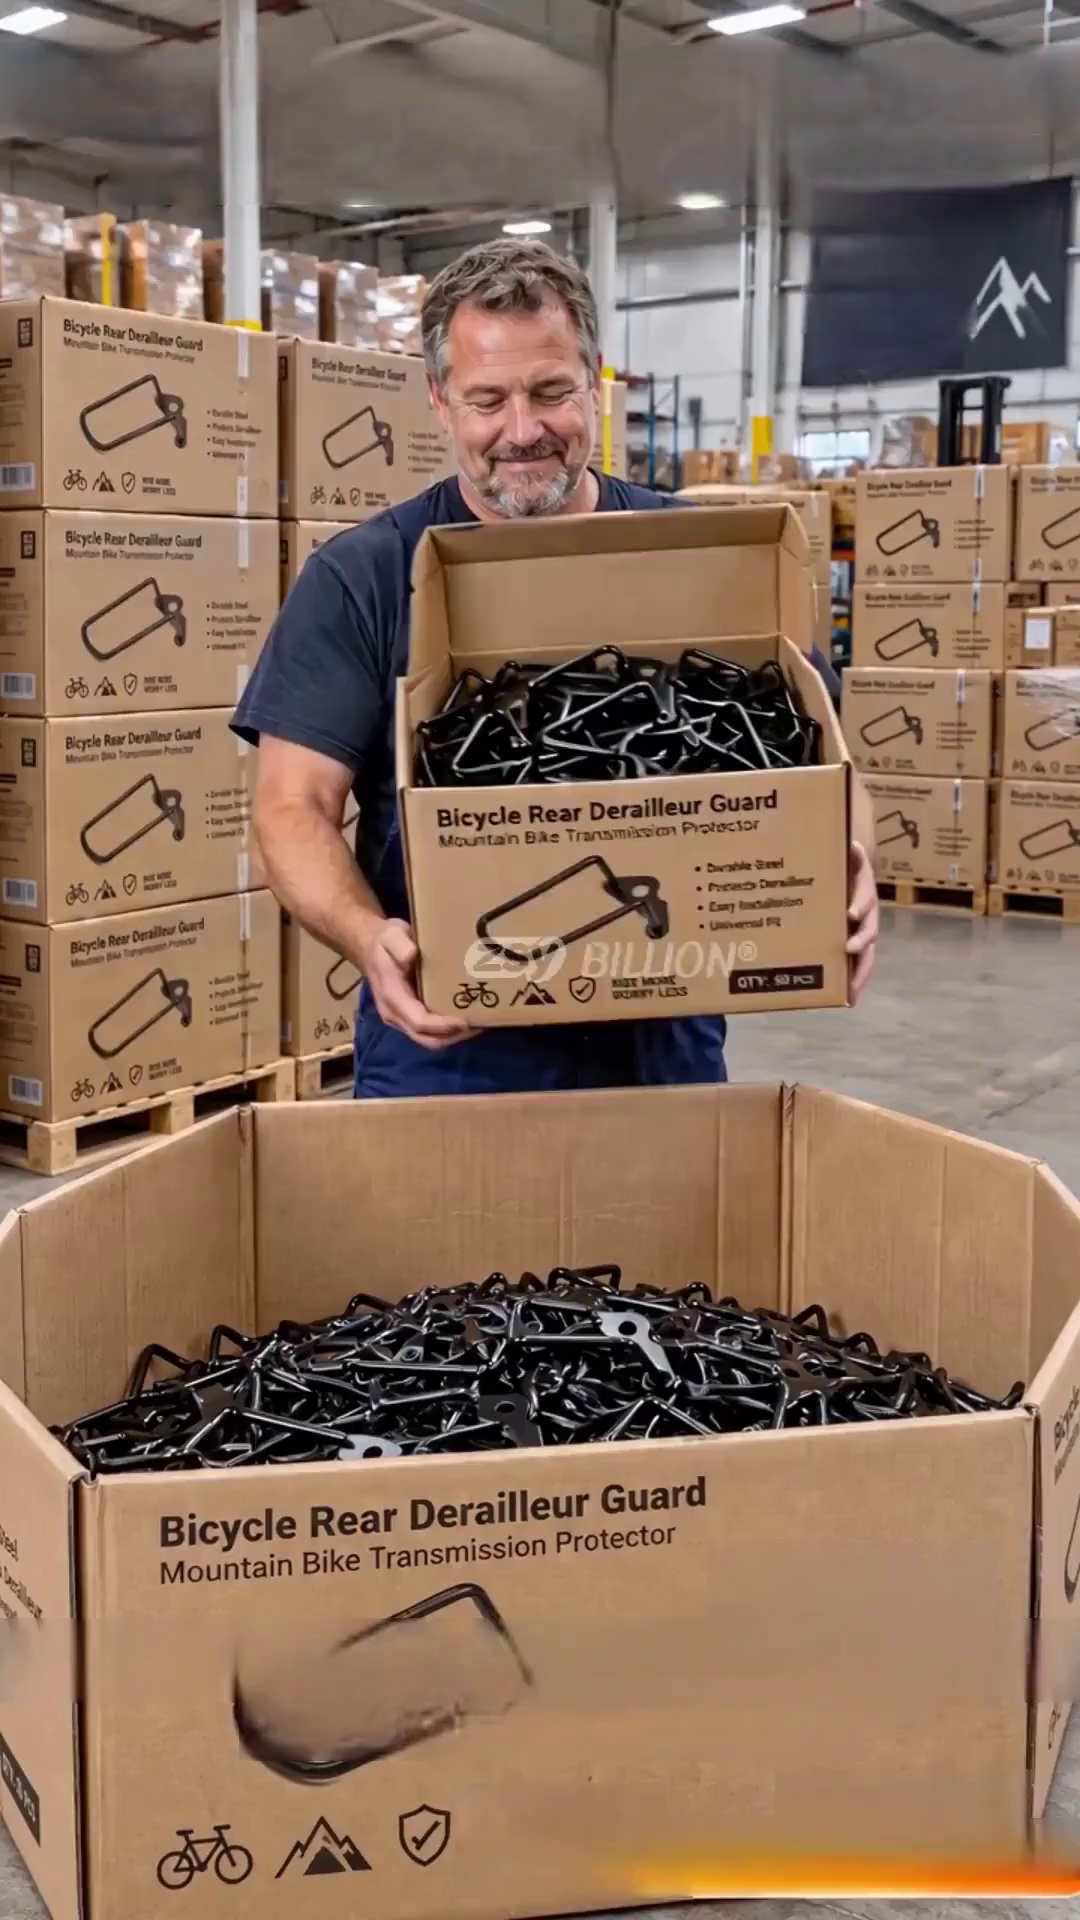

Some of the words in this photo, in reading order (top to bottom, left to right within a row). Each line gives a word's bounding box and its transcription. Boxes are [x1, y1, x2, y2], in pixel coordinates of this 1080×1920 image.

[65, 530, 102, 549] Bicycle
[436, 805, 521, 831] Bicycle
[528, 804, 582, 825] Rear
[590, 797, 702, 821] Derailleur
[710, 789, 777, 813] Guard
[438, 833, 519, 848] Mountain
[525, 831, 560, 844] Bike
[566, 824, 676, 842] Transmission
[682, 820, 760, 836] Protector
[160, 1508, 297, 1552] Bicycle
[310, 1506, 398, 1538] Rear
[410, 1490, 590, 1530] Derailleur
[601, 1476, 706, 1514] Guard
[160, 1553, 292, 1585] Mountain
[303, 1549, 361, 1575] Bike
[369, 1536, 546, 1569] Transmission
[556, 1525, 677, 1553] Protector
